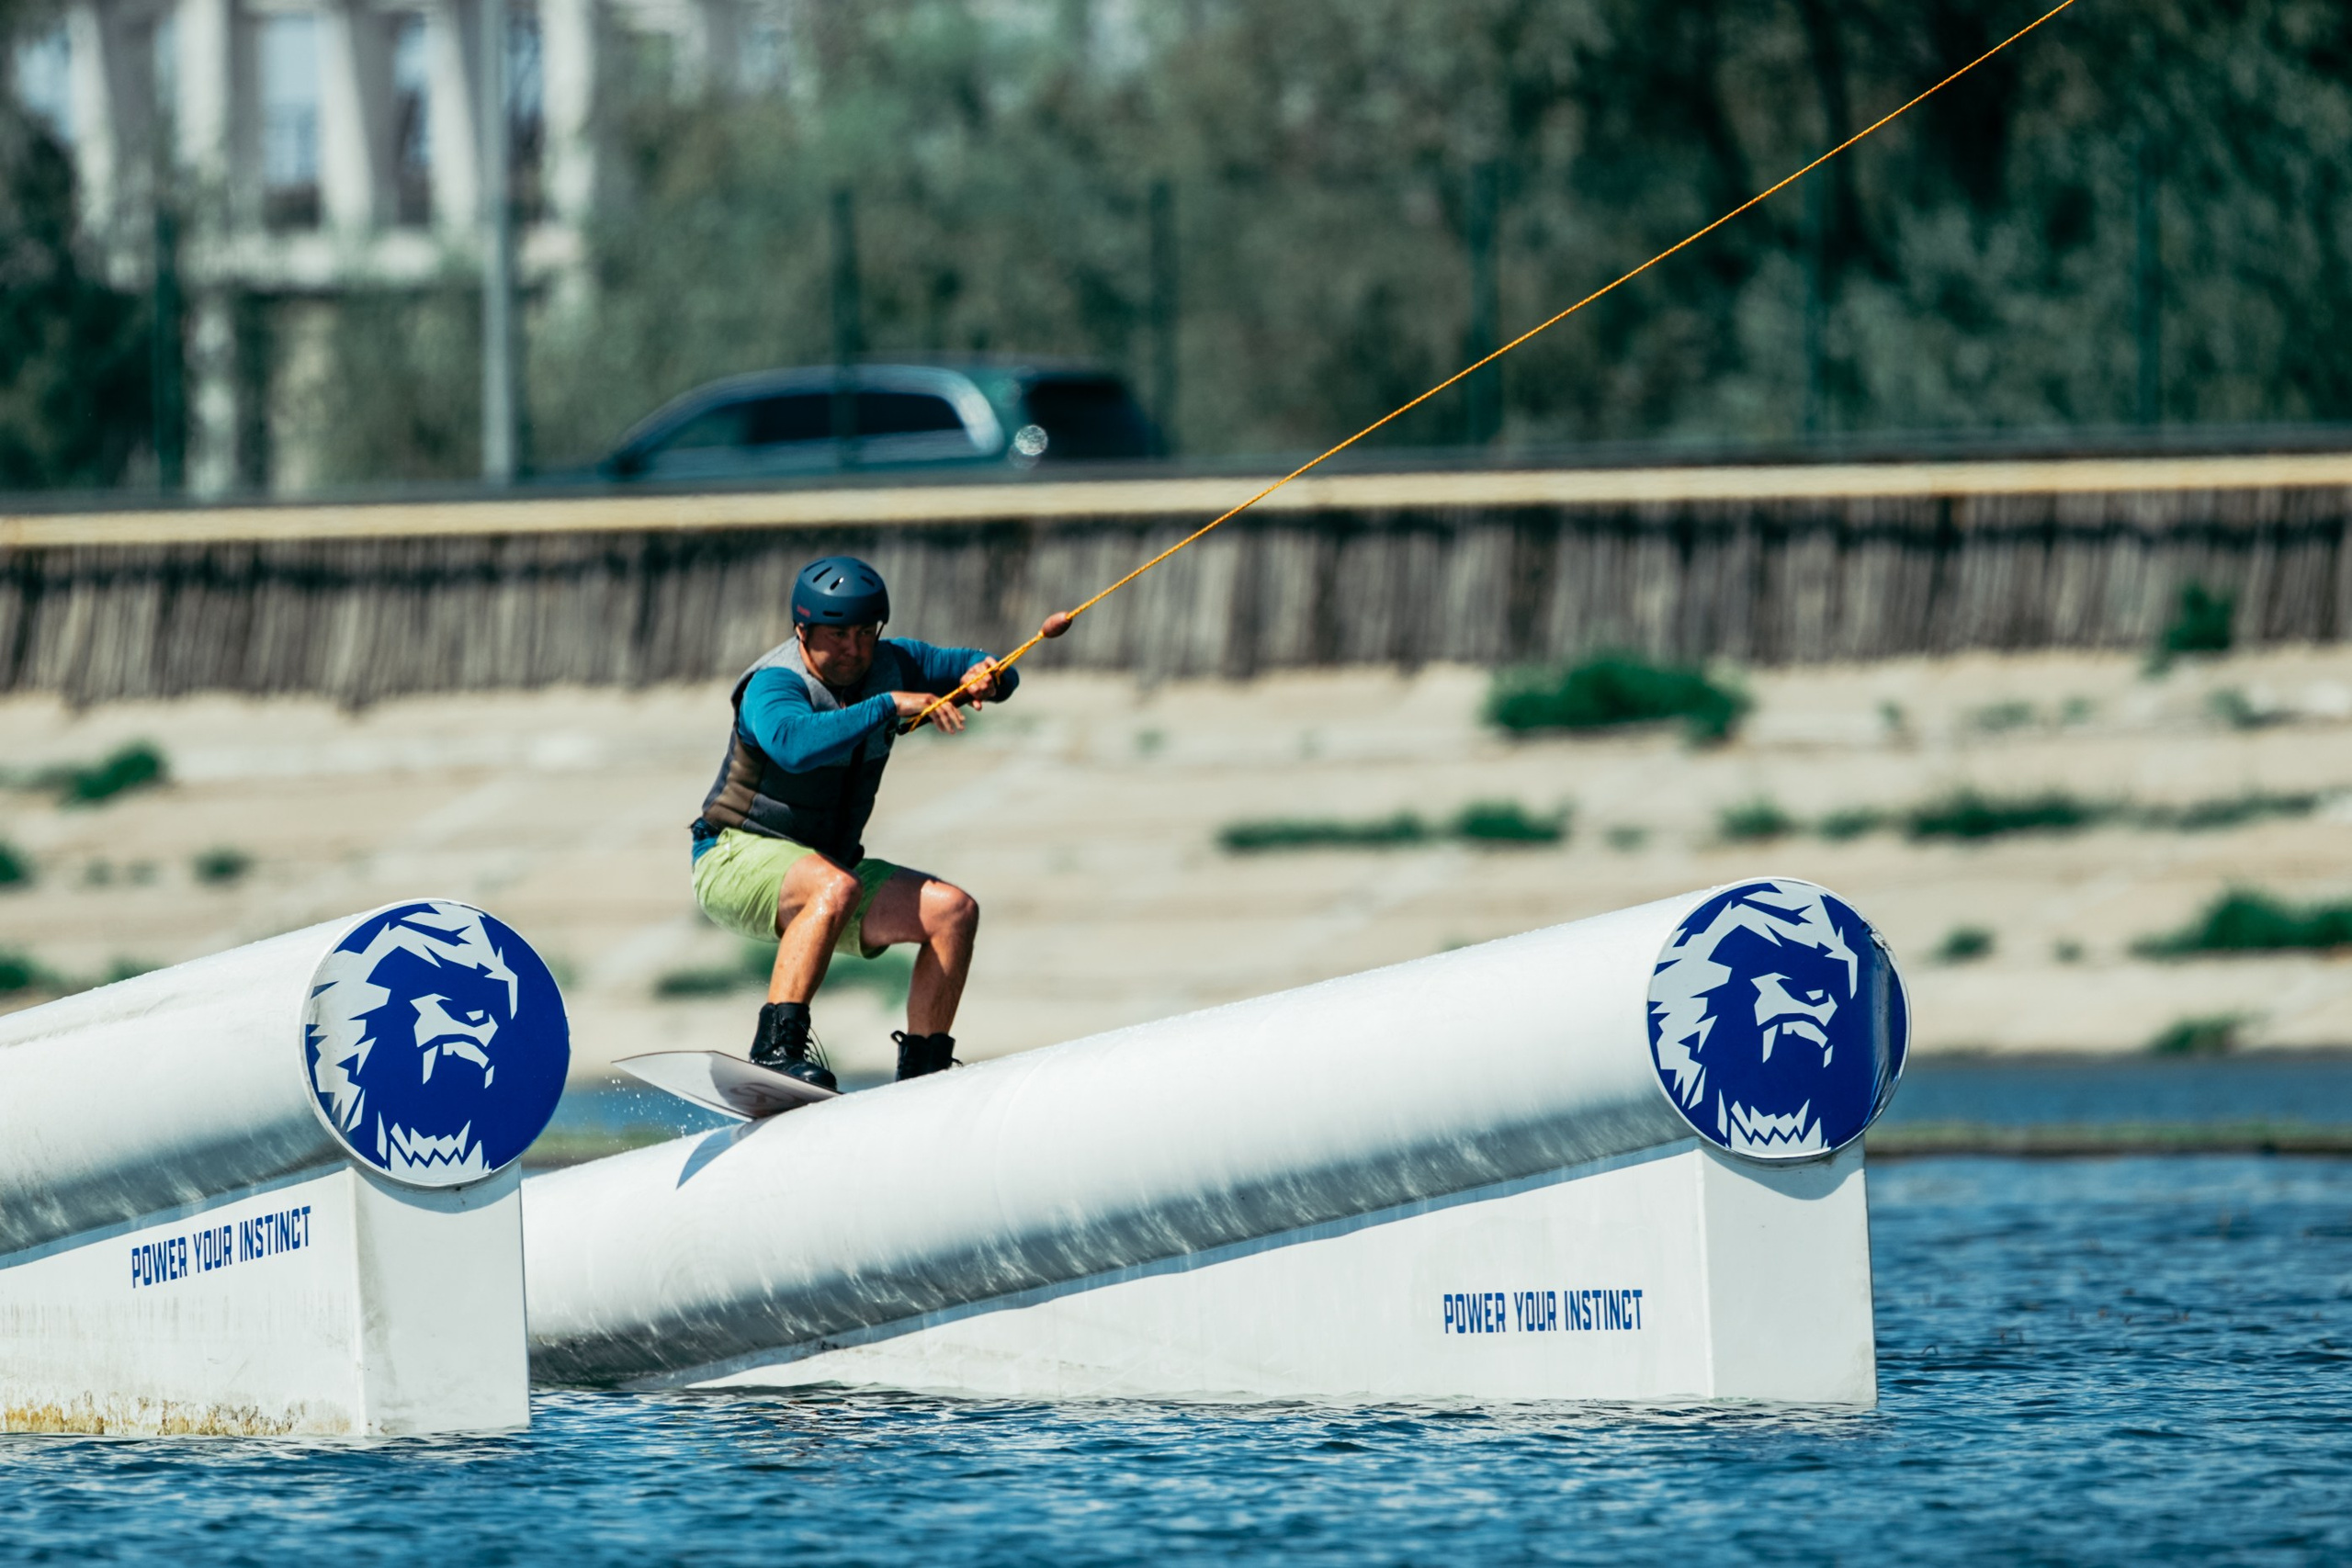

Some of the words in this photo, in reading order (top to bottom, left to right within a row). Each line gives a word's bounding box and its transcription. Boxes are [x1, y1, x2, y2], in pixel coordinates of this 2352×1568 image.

[131, 1235, 187, 1289] POWER
[193, 1224, 232, 1273] YOUR
[239, 1205, 311, 1263] INSTINCT
[1443, 1292, 1507, 1334] POWER
[1513, 1291, 1557, 1332] YOUR
[1564, 1289, 1643, 1331] INSTINCT
